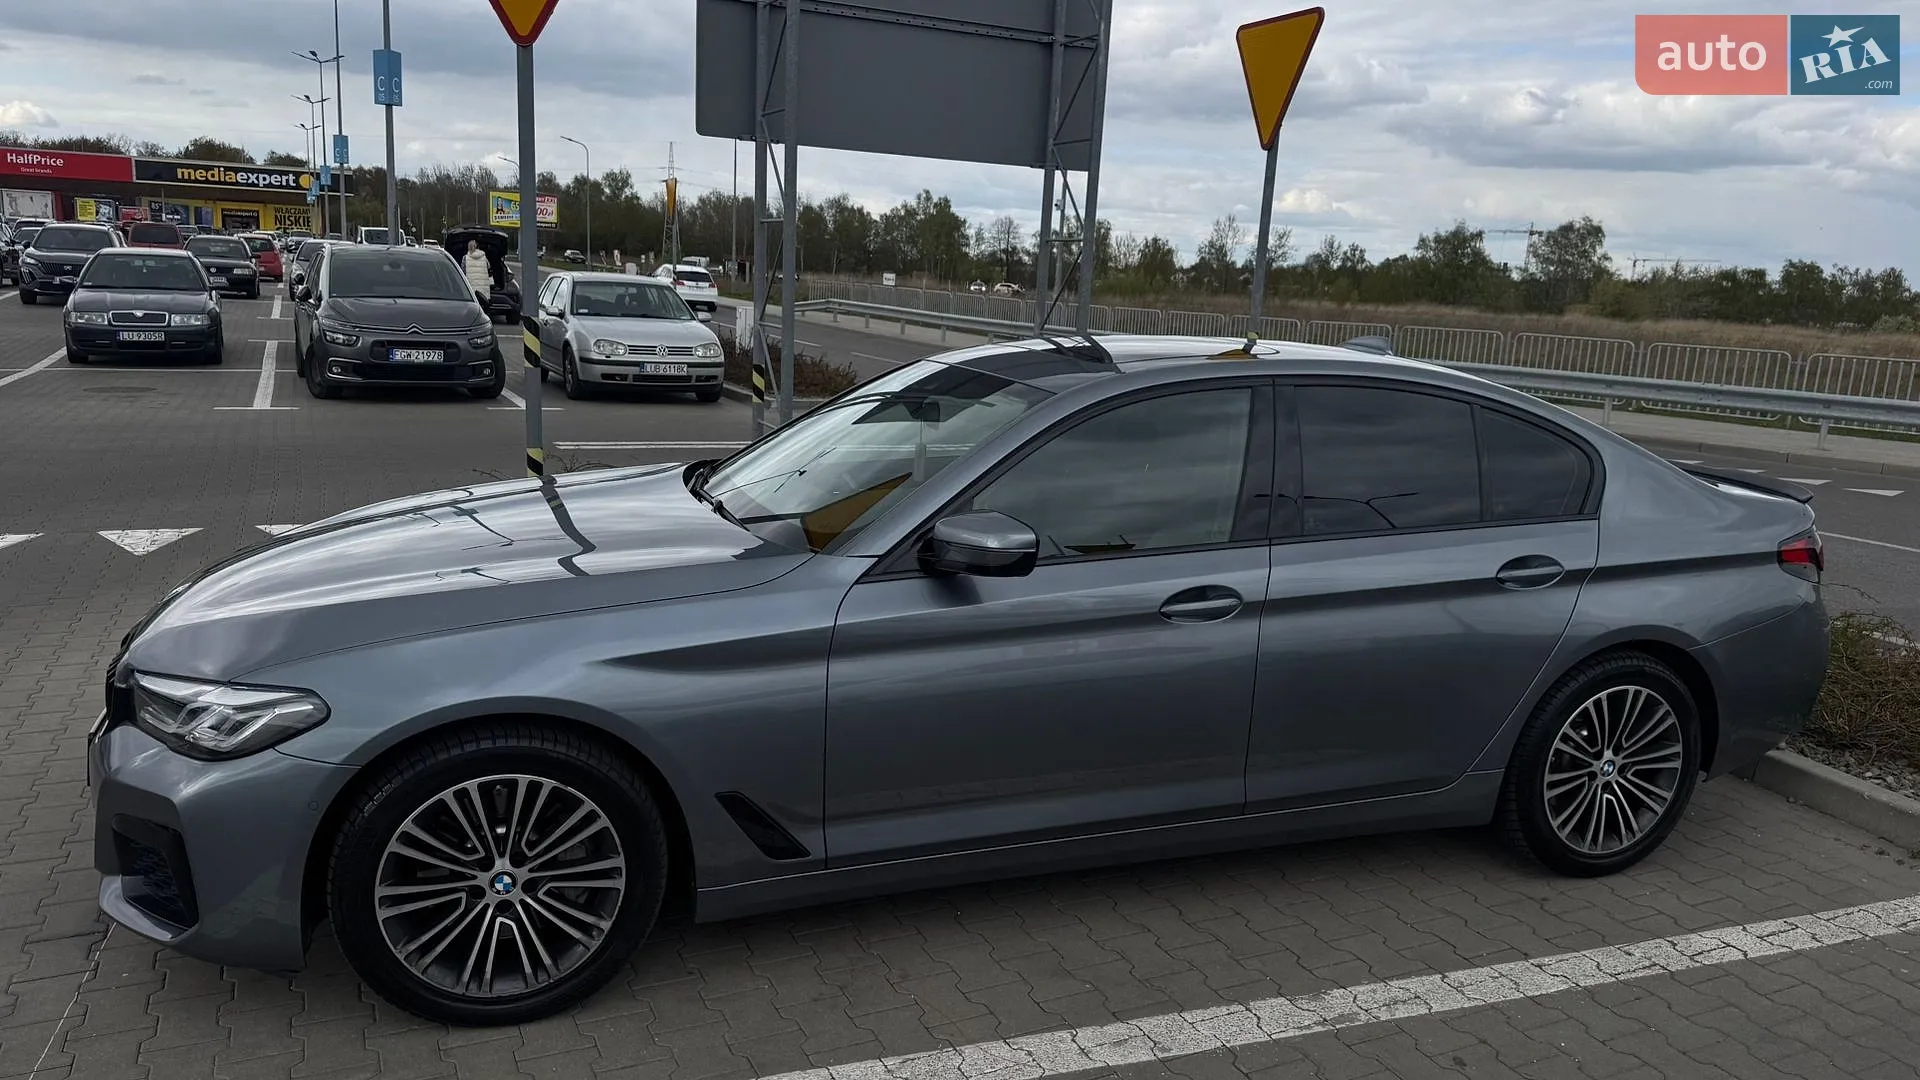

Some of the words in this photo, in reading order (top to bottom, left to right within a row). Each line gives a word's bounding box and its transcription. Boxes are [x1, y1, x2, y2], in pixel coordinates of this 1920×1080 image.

[377, 75, 385, 91] C
[392, 76, 400, 93] C
[7, 152, 64, 167] HalfPrice
[176, 166, 297, 187] mediaexpert
[274, 214, 311, 227] NISKIE
[122, 332, 134, 340] LU
[415, 350, 443, 360] 21978
